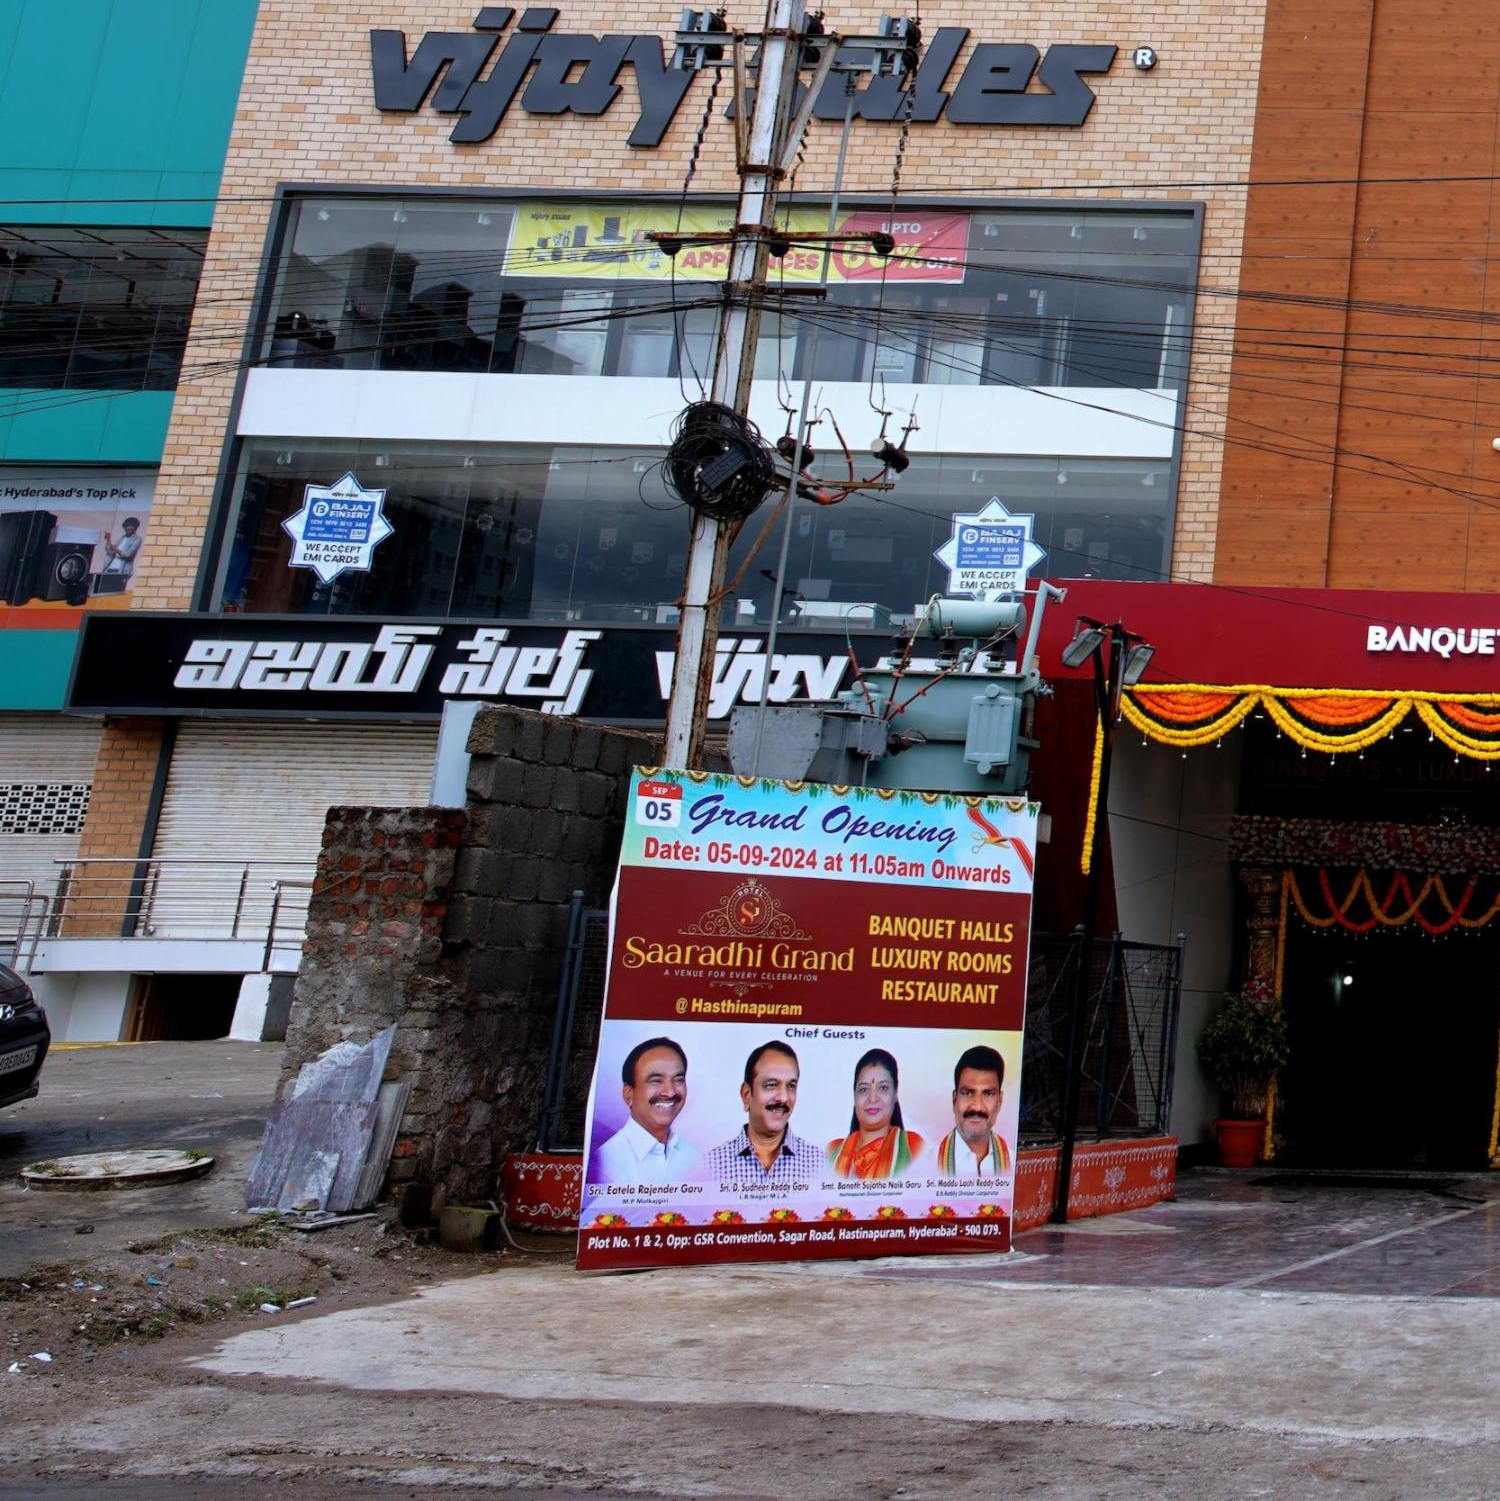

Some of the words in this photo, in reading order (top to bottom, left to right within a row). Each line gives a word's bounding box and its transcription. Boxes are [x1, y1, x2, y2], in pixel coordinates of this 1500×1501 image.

[370, 7, 704, 147] vijay
[881, 222, 921, 234] UPTO
[5, 487, 83, 499] Hyderabad's
[86, 488, 107, 500] Top
[110, 488, 136, 498] Pick
[331, 503, 371, 511] BAJAJ
[306, 543, 321, 551] WE
[323, 544, 362, 553] ACCEPT
[303, 553, 321, 562] EMI
[324, 554, 359, 564] CARDS
[978, 571, 1016, 579] ACCEPT
[960, 581, 977, 589] EMI
[980, 581, 1016, 589] CARDS
[652, 787, 668, 795] SEP
[645, 801, 672, 821] 05
[689, 794, 808, 835] Grand
[821, 805, 957, 853] Opening
[644, 837, 700, 861] Date:
[707, 842, 817, 869] 05-09-2024
[824, 853, 842, 872] at
[850, 853, 925, 878] 11.05am
[931, 859, 1011, 884] Onwards
[737, 887, 764, 898] HOTEL
[869, 915, 955, 941] BANQUET
[960, 921, 1013, 943] HALLS
[622, 936, 763, 969] Saaradhi
[771, 943, 855, 971] Grand
[871, 947, 943, 970] LUXURY
[947, 951, 1012, 974] ROOMS
[674, 970, 704, 978] VENUE
[708, 971, 726, 979] FOR
[730, 972, 757, 980] EVERY
[761, 972, 818, 982] CELEBRATION
[881, 980, 999, 1005] RESTAURANT
[675, 998, 688, 1014] @
[691, 998, 802, 1018] Hasthinapuram
[785, 1027, 819, 1039] Chief
[822, 1029, 865, 1040] Guests
[589, 1185, 604, 1196] Sri.
[638, 1184, 678, 1197] Rajender
[681, 1184, 703, 1194] Garu
[771, 1182, 791, 1194] Reddy
[792, 1182, 809, 1192] Garu
[588, 1236, 610, 1250] Plot
[612, 1235, 630, 1248] No.
[634, 1235, 640, 1247] 1
[642, 1235, 652, 1247] &
[654, 1234, 664, 1248] 2,
[666, 1233, 691, 1249] Opp:
[694, 1232, 714, 1245] GSR
[716, 1229, 776, 1245] Convention,
[779, 1229, 806, 1245] Sagar
[809, 1228, 836, 1242] Road,
[838, 1226, 906, 1241] Hastinapuram,
[908, 1224, 957, 1240] Hyderabad
[965, 1224, 980, 1236] 500
[982, 1224, 1001, 1236] 079.
